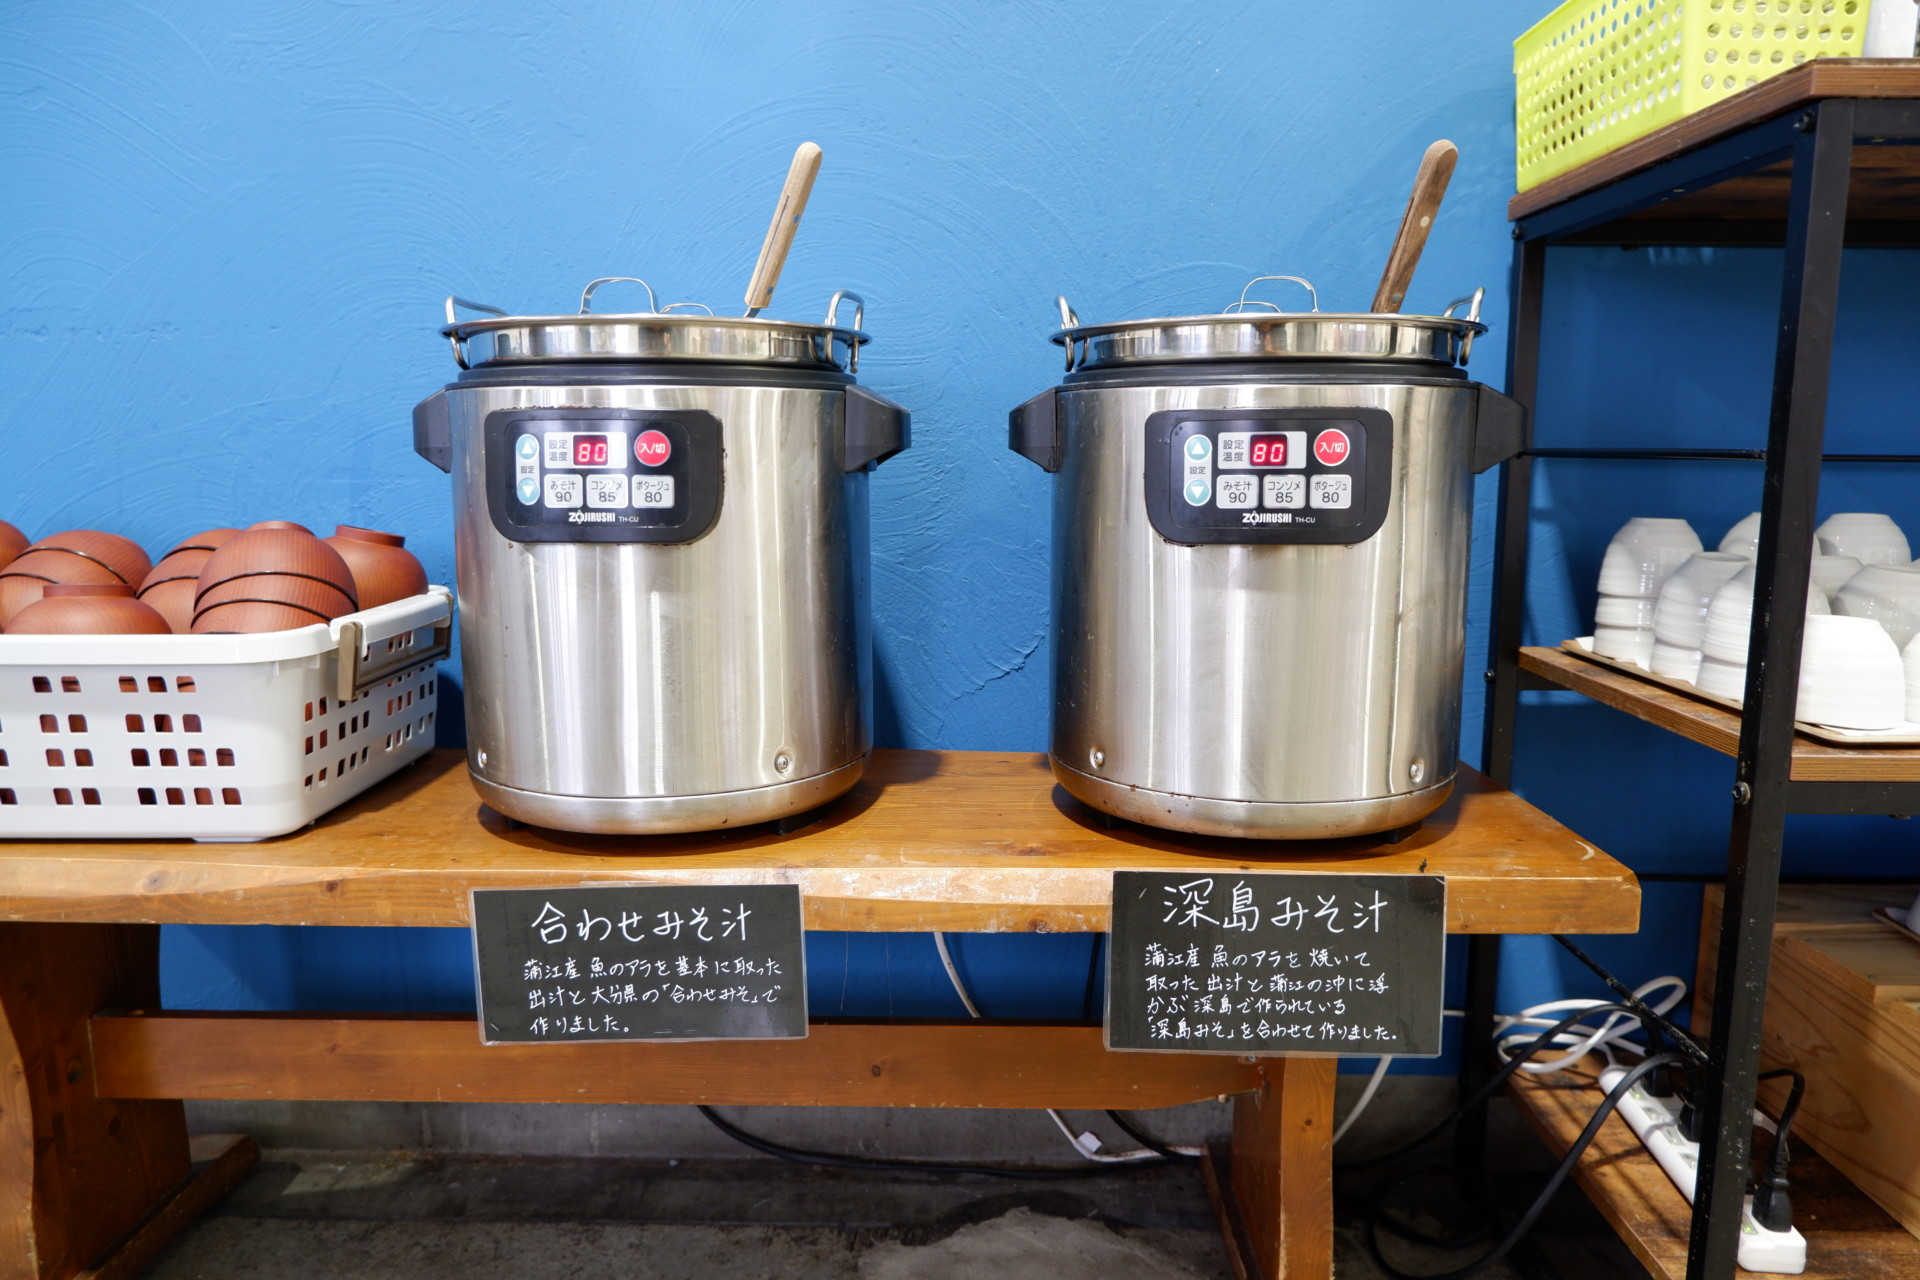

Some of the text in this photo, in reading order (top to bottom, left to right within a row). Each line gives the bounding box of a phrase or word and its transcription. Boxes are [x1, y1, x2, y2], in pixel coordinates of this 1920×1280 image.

[549, 440, 568, 449] 設定
[640, 443, 665, 454] 入/切
[1224, 440, 1244, 449] 設定
[1320, 442, 1344, 452] 入/切
[549, 452, 568, 461] 温度
[578, 444, 607, 462] 80
[1223, 452, 1244, 462] 温度
[1253, 444, 1284, 462] 80
[521, 466, 534, 474] 設定
[1190, 466, 1206, 474] 設定
[550, 481, 576, 490] みそ汁
[591, 481, 623, 490] コンソメ
[1223, 481, 1252, 491] みそ汁
[1268, 481, 1300, 491] コンソメ
[1315, 481, 1347, 491] ポタージュ
[555, 492, 571, 502] 90
[599, 492, 615, 502] 85
[645, 492, 662, 503] 80
[1229, 493, 1246, 503] 90
[1276, 493, 1292, 503] 85
[1322, 493, 1339, 503] 80
[568, 510, 615, 524] ZOJIRUSHI
[1242, 511, 1292, 525] ZOJIRUSHI
[1163, 878, 1388, 933] 深島みそ汁
[530, 901, 751, 944] 合わせみそ汁
